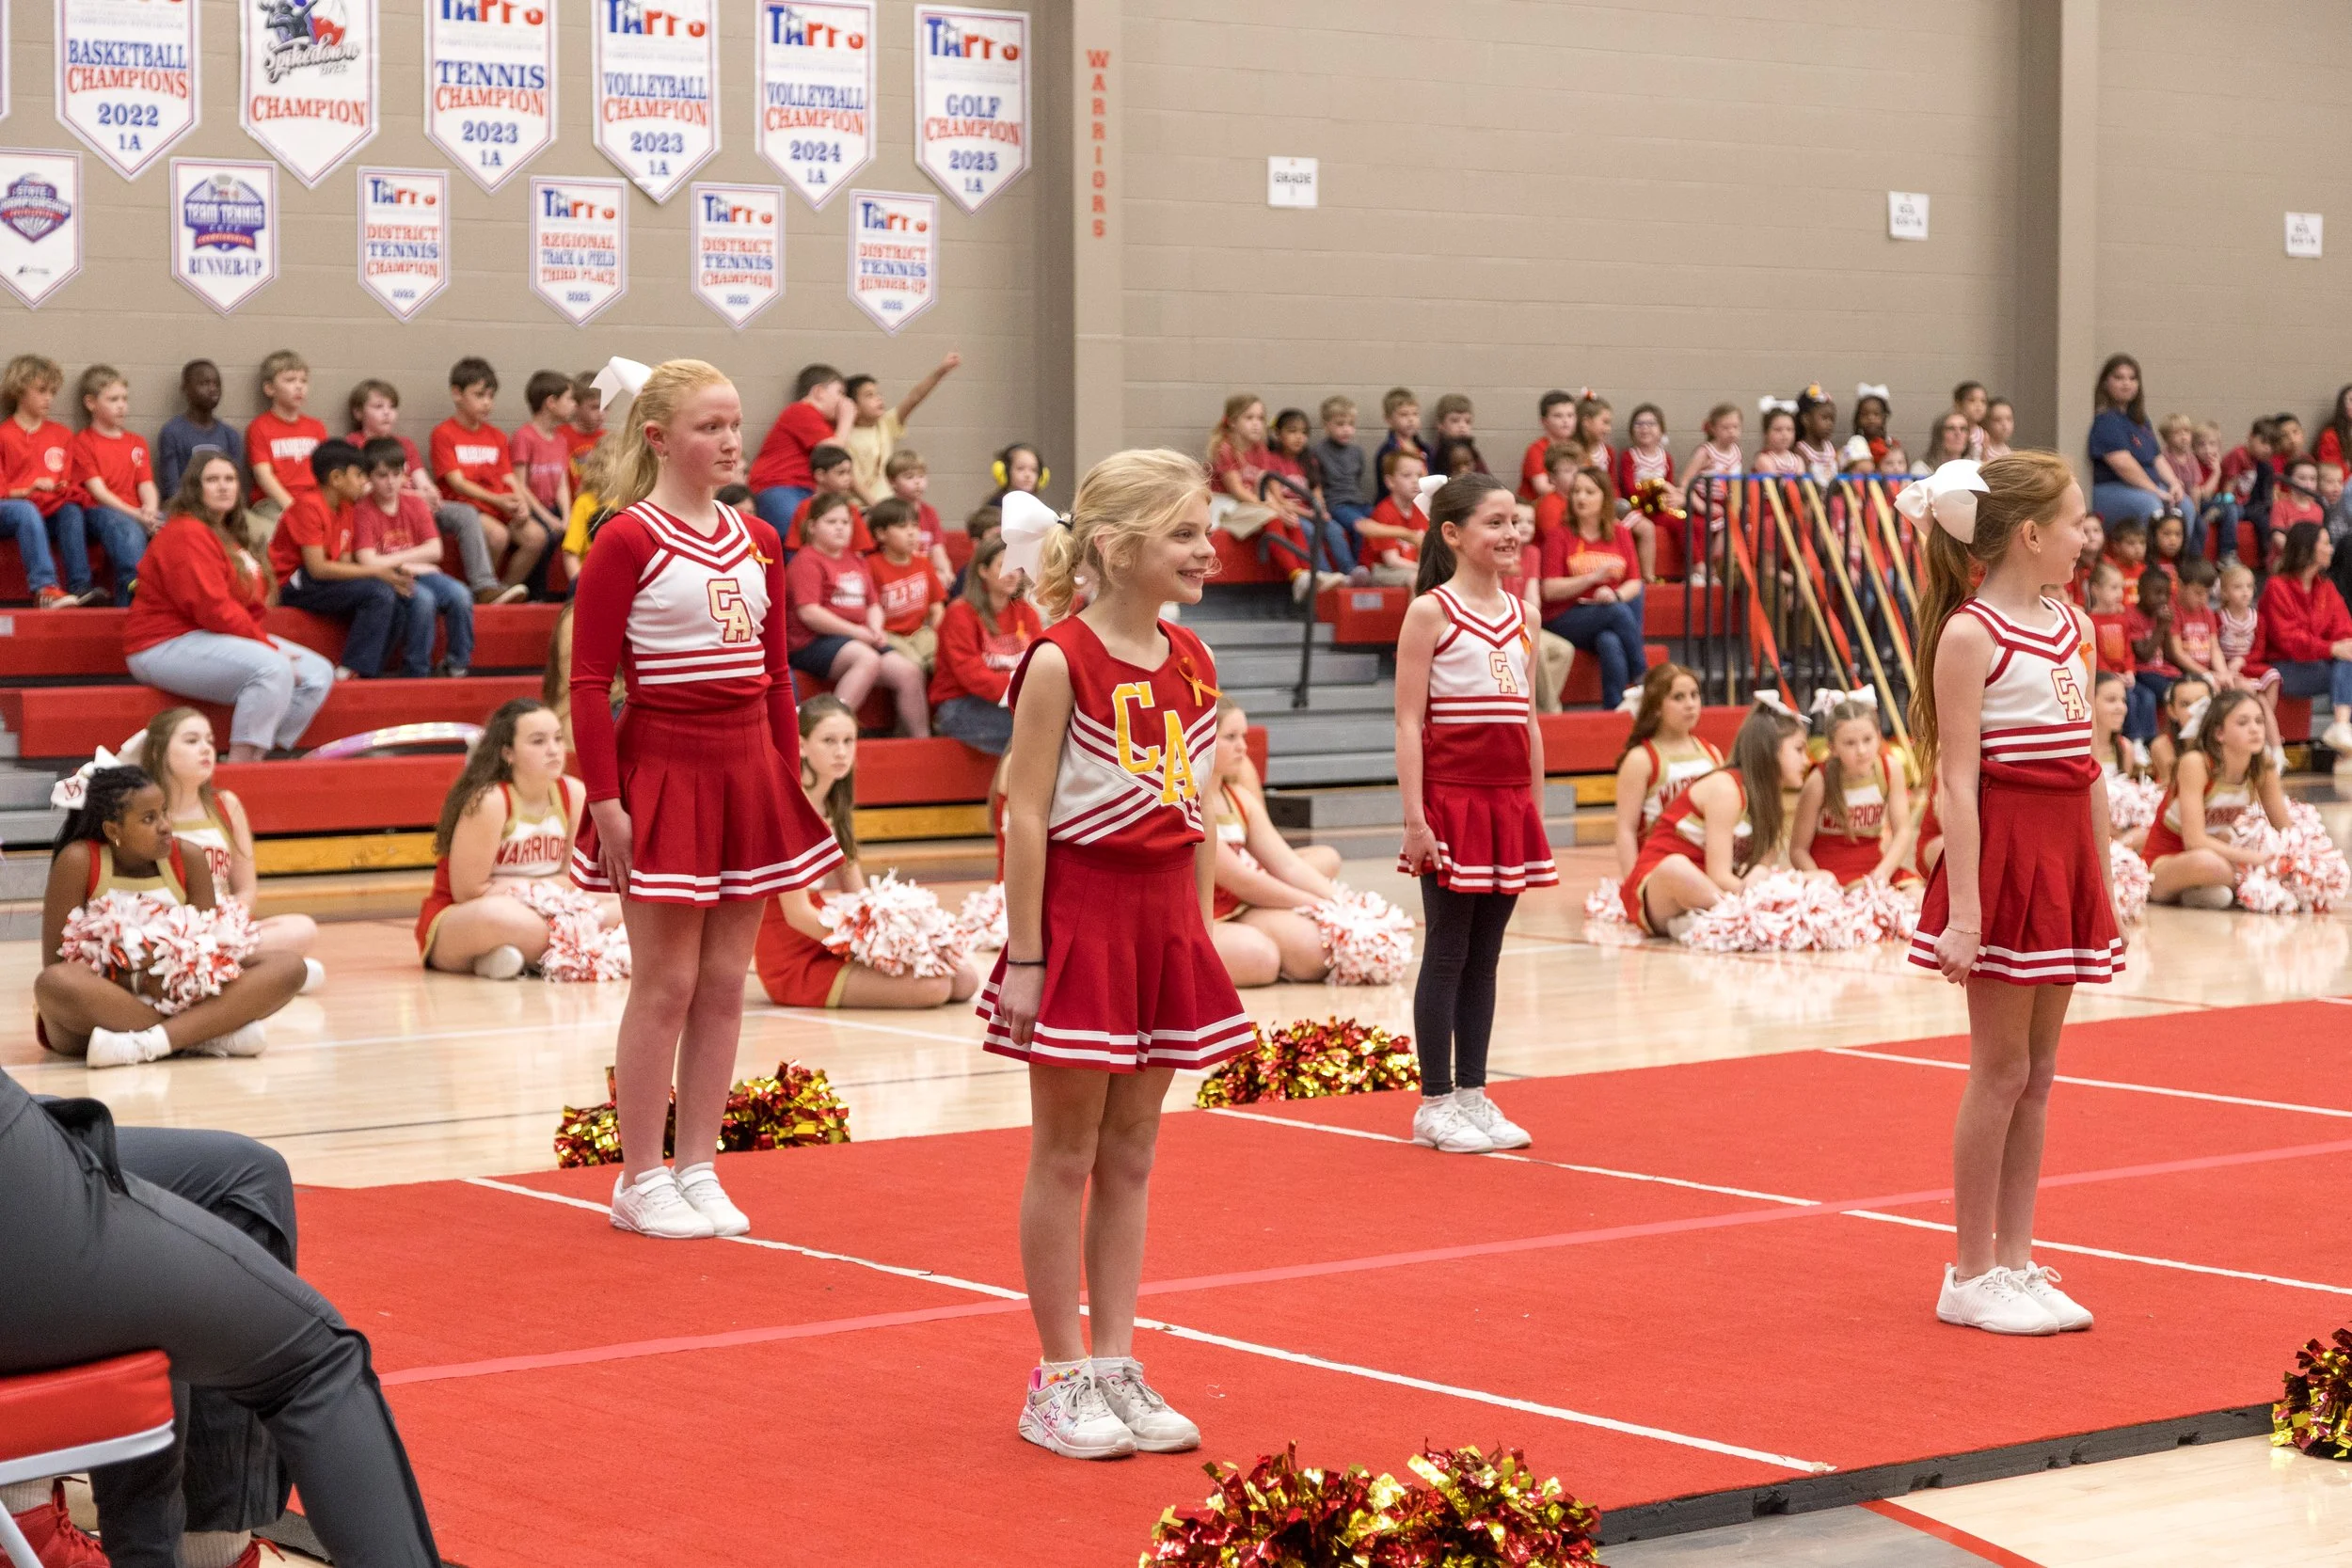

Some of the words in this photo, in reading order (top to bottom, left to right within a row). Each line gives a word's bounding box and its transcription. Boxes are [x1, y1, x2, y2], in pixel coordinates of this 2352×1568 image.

[68, 39, 187, 70] BASKETBALL
[68, 66, 188, 100] CHAMPIONS
[435, 59, 546, 89] TENNIS
[604, 71, 707, 100] VOLLEYBALL
[436, 85, 545, 117] CHAMPION
[767, 81, 865, 110] VOLLEYBALL
[946, 94, 1002, 119] GOLF
[98, 103, 159, 127] 2022
[251, 95, 365, 127] CHAMPION
[603, 97, 707, 127] CHAMPION
[765, 105, 864, 136] CHAMPION
[119, 133, 142, 150] 1A
[462, 120, 518, 144] 2023
[630, 131, 684, 153] 2023
[925, 117, 1021, 146] CHAMPION
[790, 139, 841, 163] 2024
[1086, 50, 1111, 238] WARRIORS
[481, 150, 502, 166] 1A
[649, 159, 670, 176] 1A
[949, 150, 998, 171] 2025
[807, 167, 827, 183] 1A
[964, 177, 984, 192] 1A
[185, 203, 218, 224] TEAM
[220, 204, 262, 225] TENNIS
[366, 224, 439, 241] DISTRICT
[541, 232, 615, 249] REGIONAL
[366, 242, 438, 259] TENNIS
[702, 237, 772, 253] DISTRICT
[858, 244, 927, 261] DISTRICT
[188, 256, 262, 276] RUNNER-UP
[366, 259, 438, 278] CHAMPION
[541, 248, 574, 264] TRACK
[586, 250, 616, 267] FIELD
[702, 253, 773, 270] TENNIS
[858, 259, 927, 277] TENNIS
[541, 267, 577, 283] THIRD
[580, 268, 615, 286] PLACE
[702, 270, 772, 290] CHAMPION
[707, 577, 754, 644] CA
[1488, 651, 1518, 694] CA
[2051, 666, 2086, 721] CA
[1111, 680, 1199, 807] CA
[494, 834, 565, 865] WARRIO
